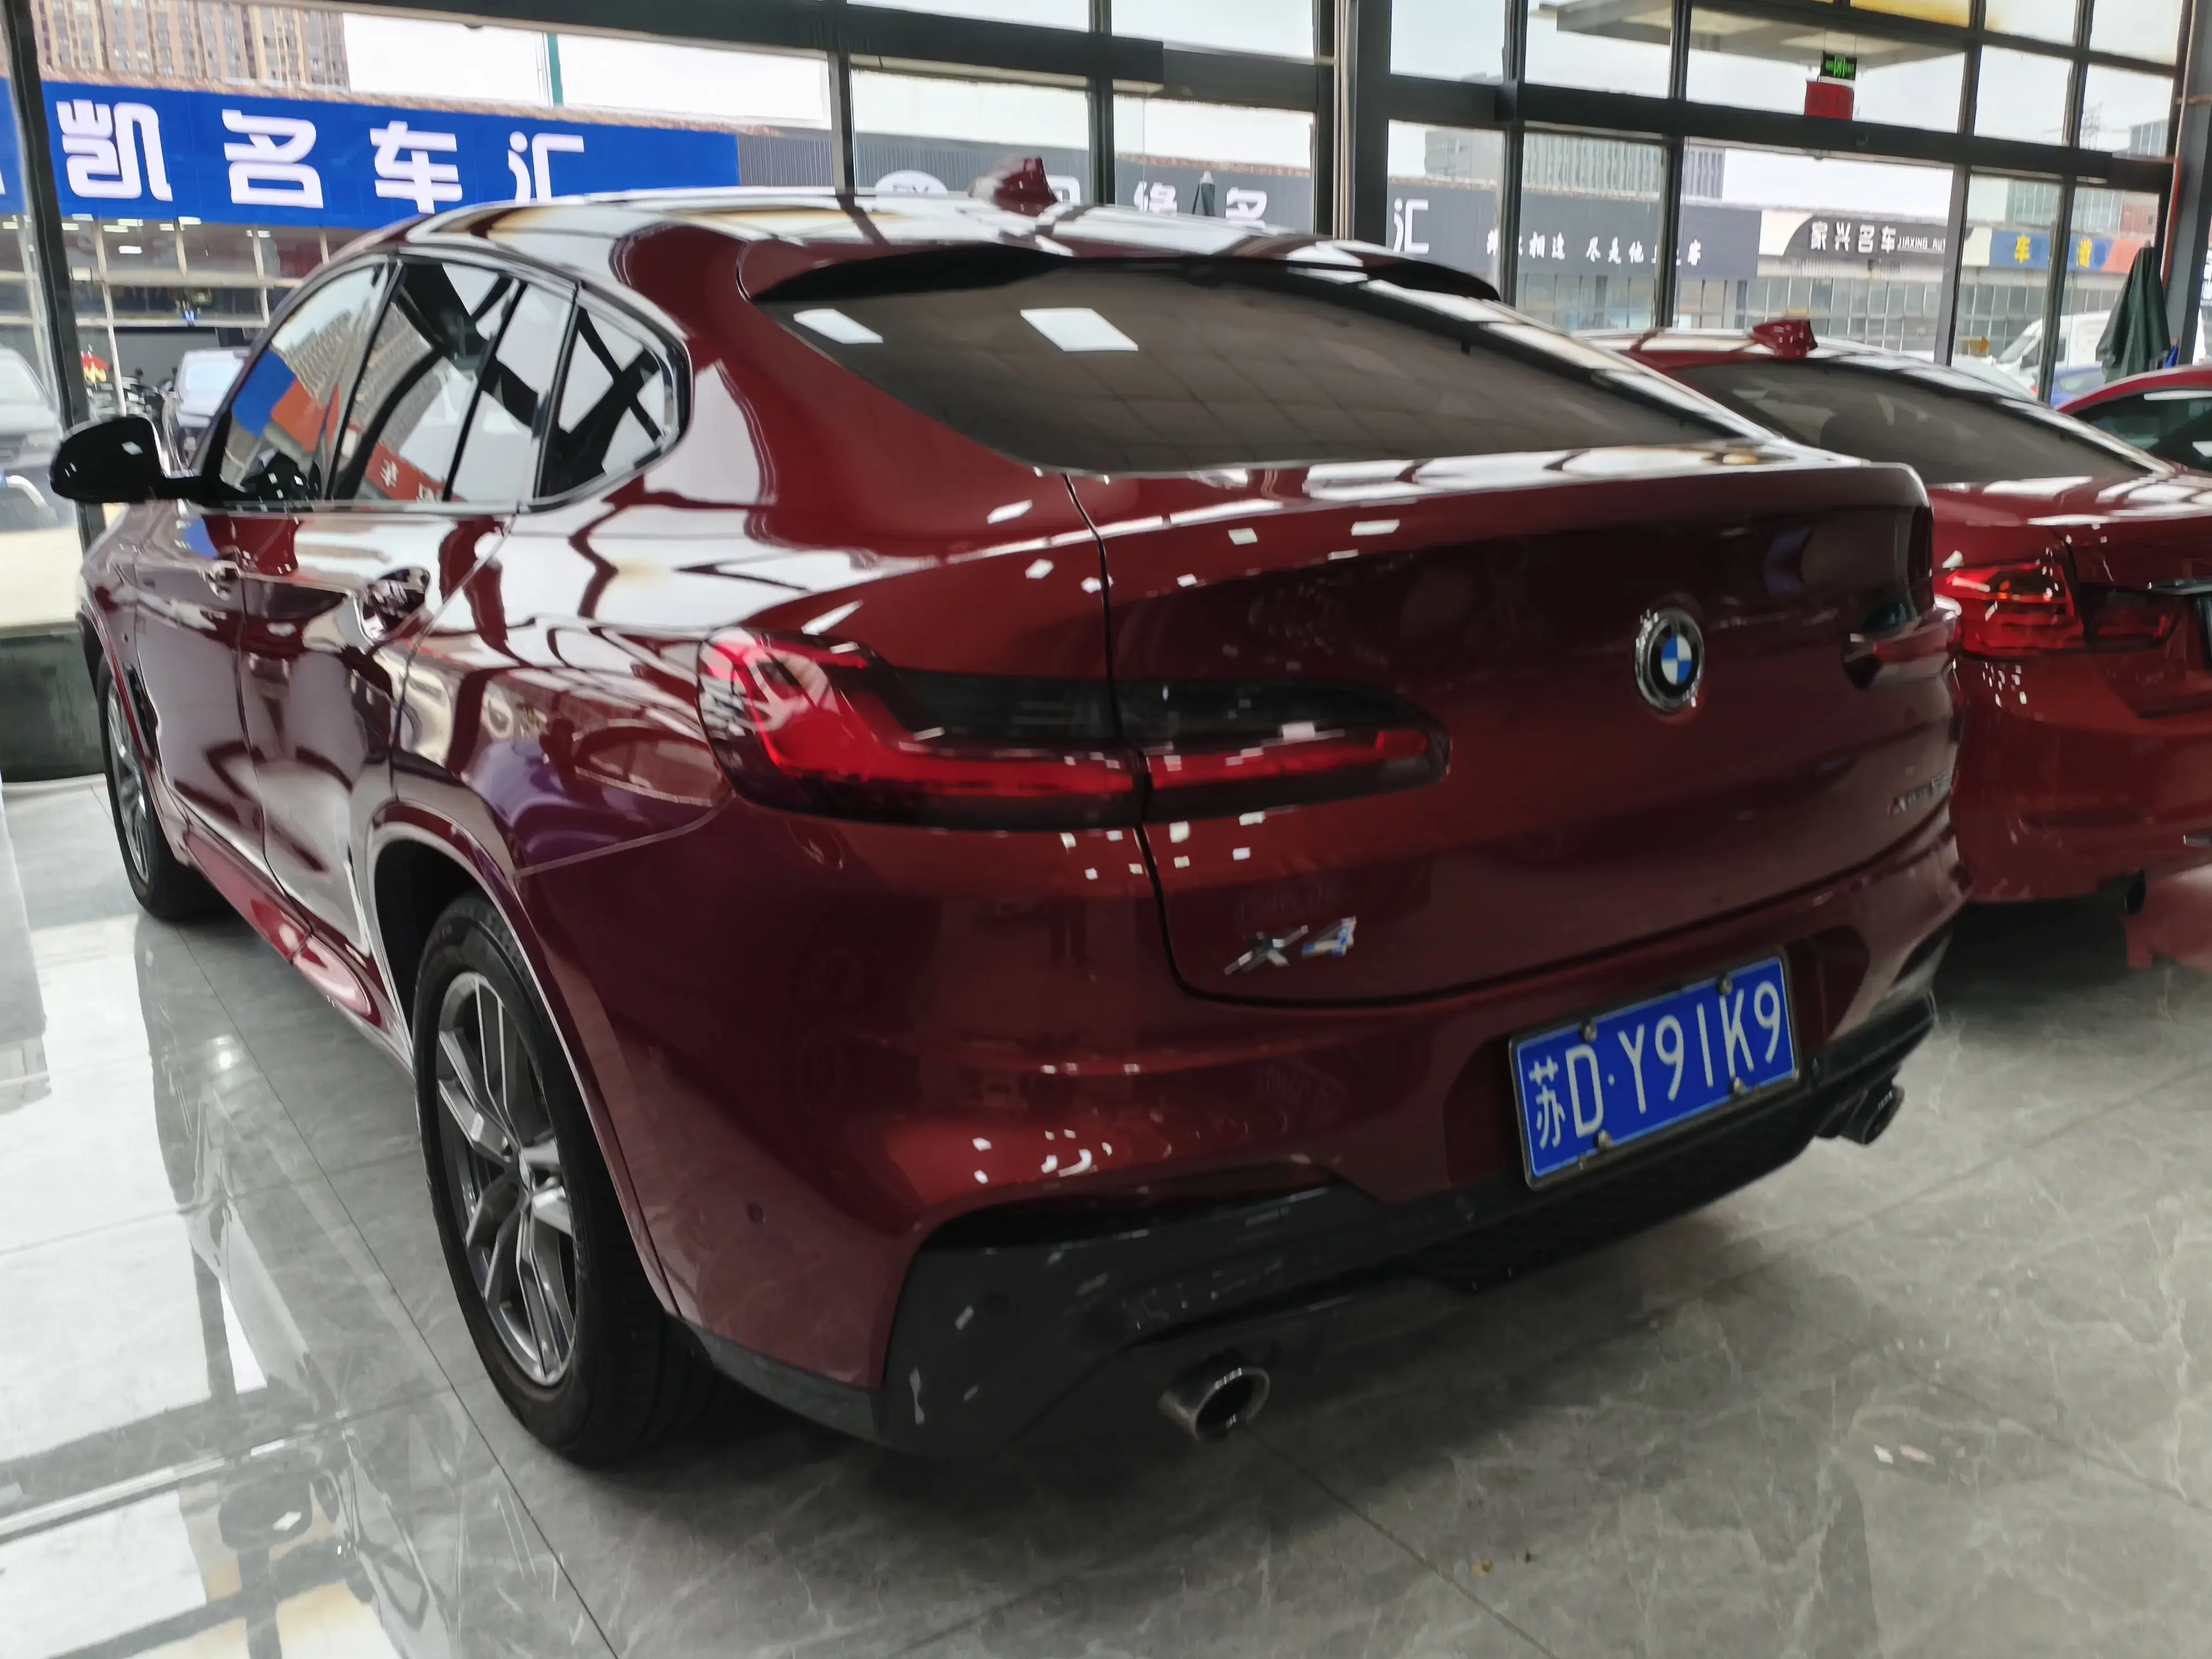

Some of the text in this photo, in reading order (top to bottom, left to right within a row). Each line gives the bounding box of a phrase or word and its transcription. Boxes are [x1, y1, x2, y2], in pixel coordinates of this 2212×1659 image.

[56, 98, 585, 213] 凯名车汇
[1811, 221, 1897, 253] 家兴名车
[1898, 235, 1928, 250] JIAXING
[1224, 916, 1357, 976] X4
